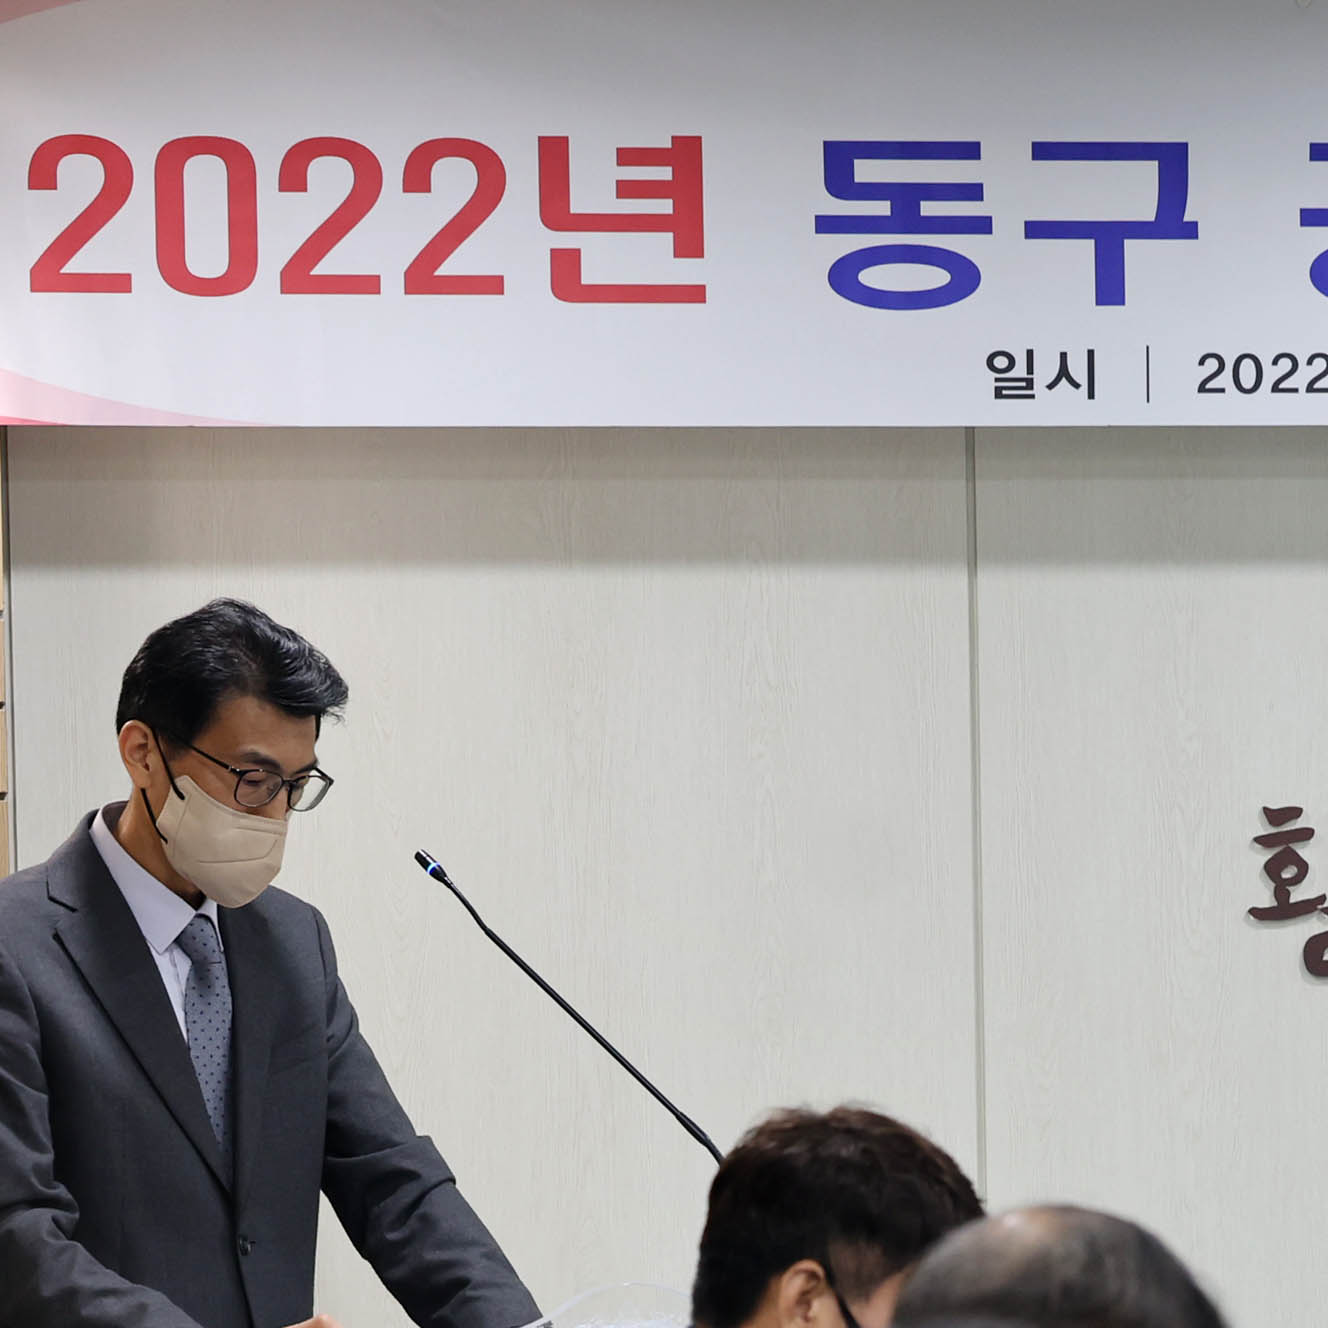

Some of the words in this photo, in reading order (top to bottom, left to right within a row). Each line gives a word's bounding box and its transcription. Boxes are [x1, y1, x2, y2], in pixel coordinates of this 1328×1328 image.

[27, 132, 708, 305] 2022년
[813, 138, 1200, 312] 동구
[985, 347, 1097, 402] 일시
